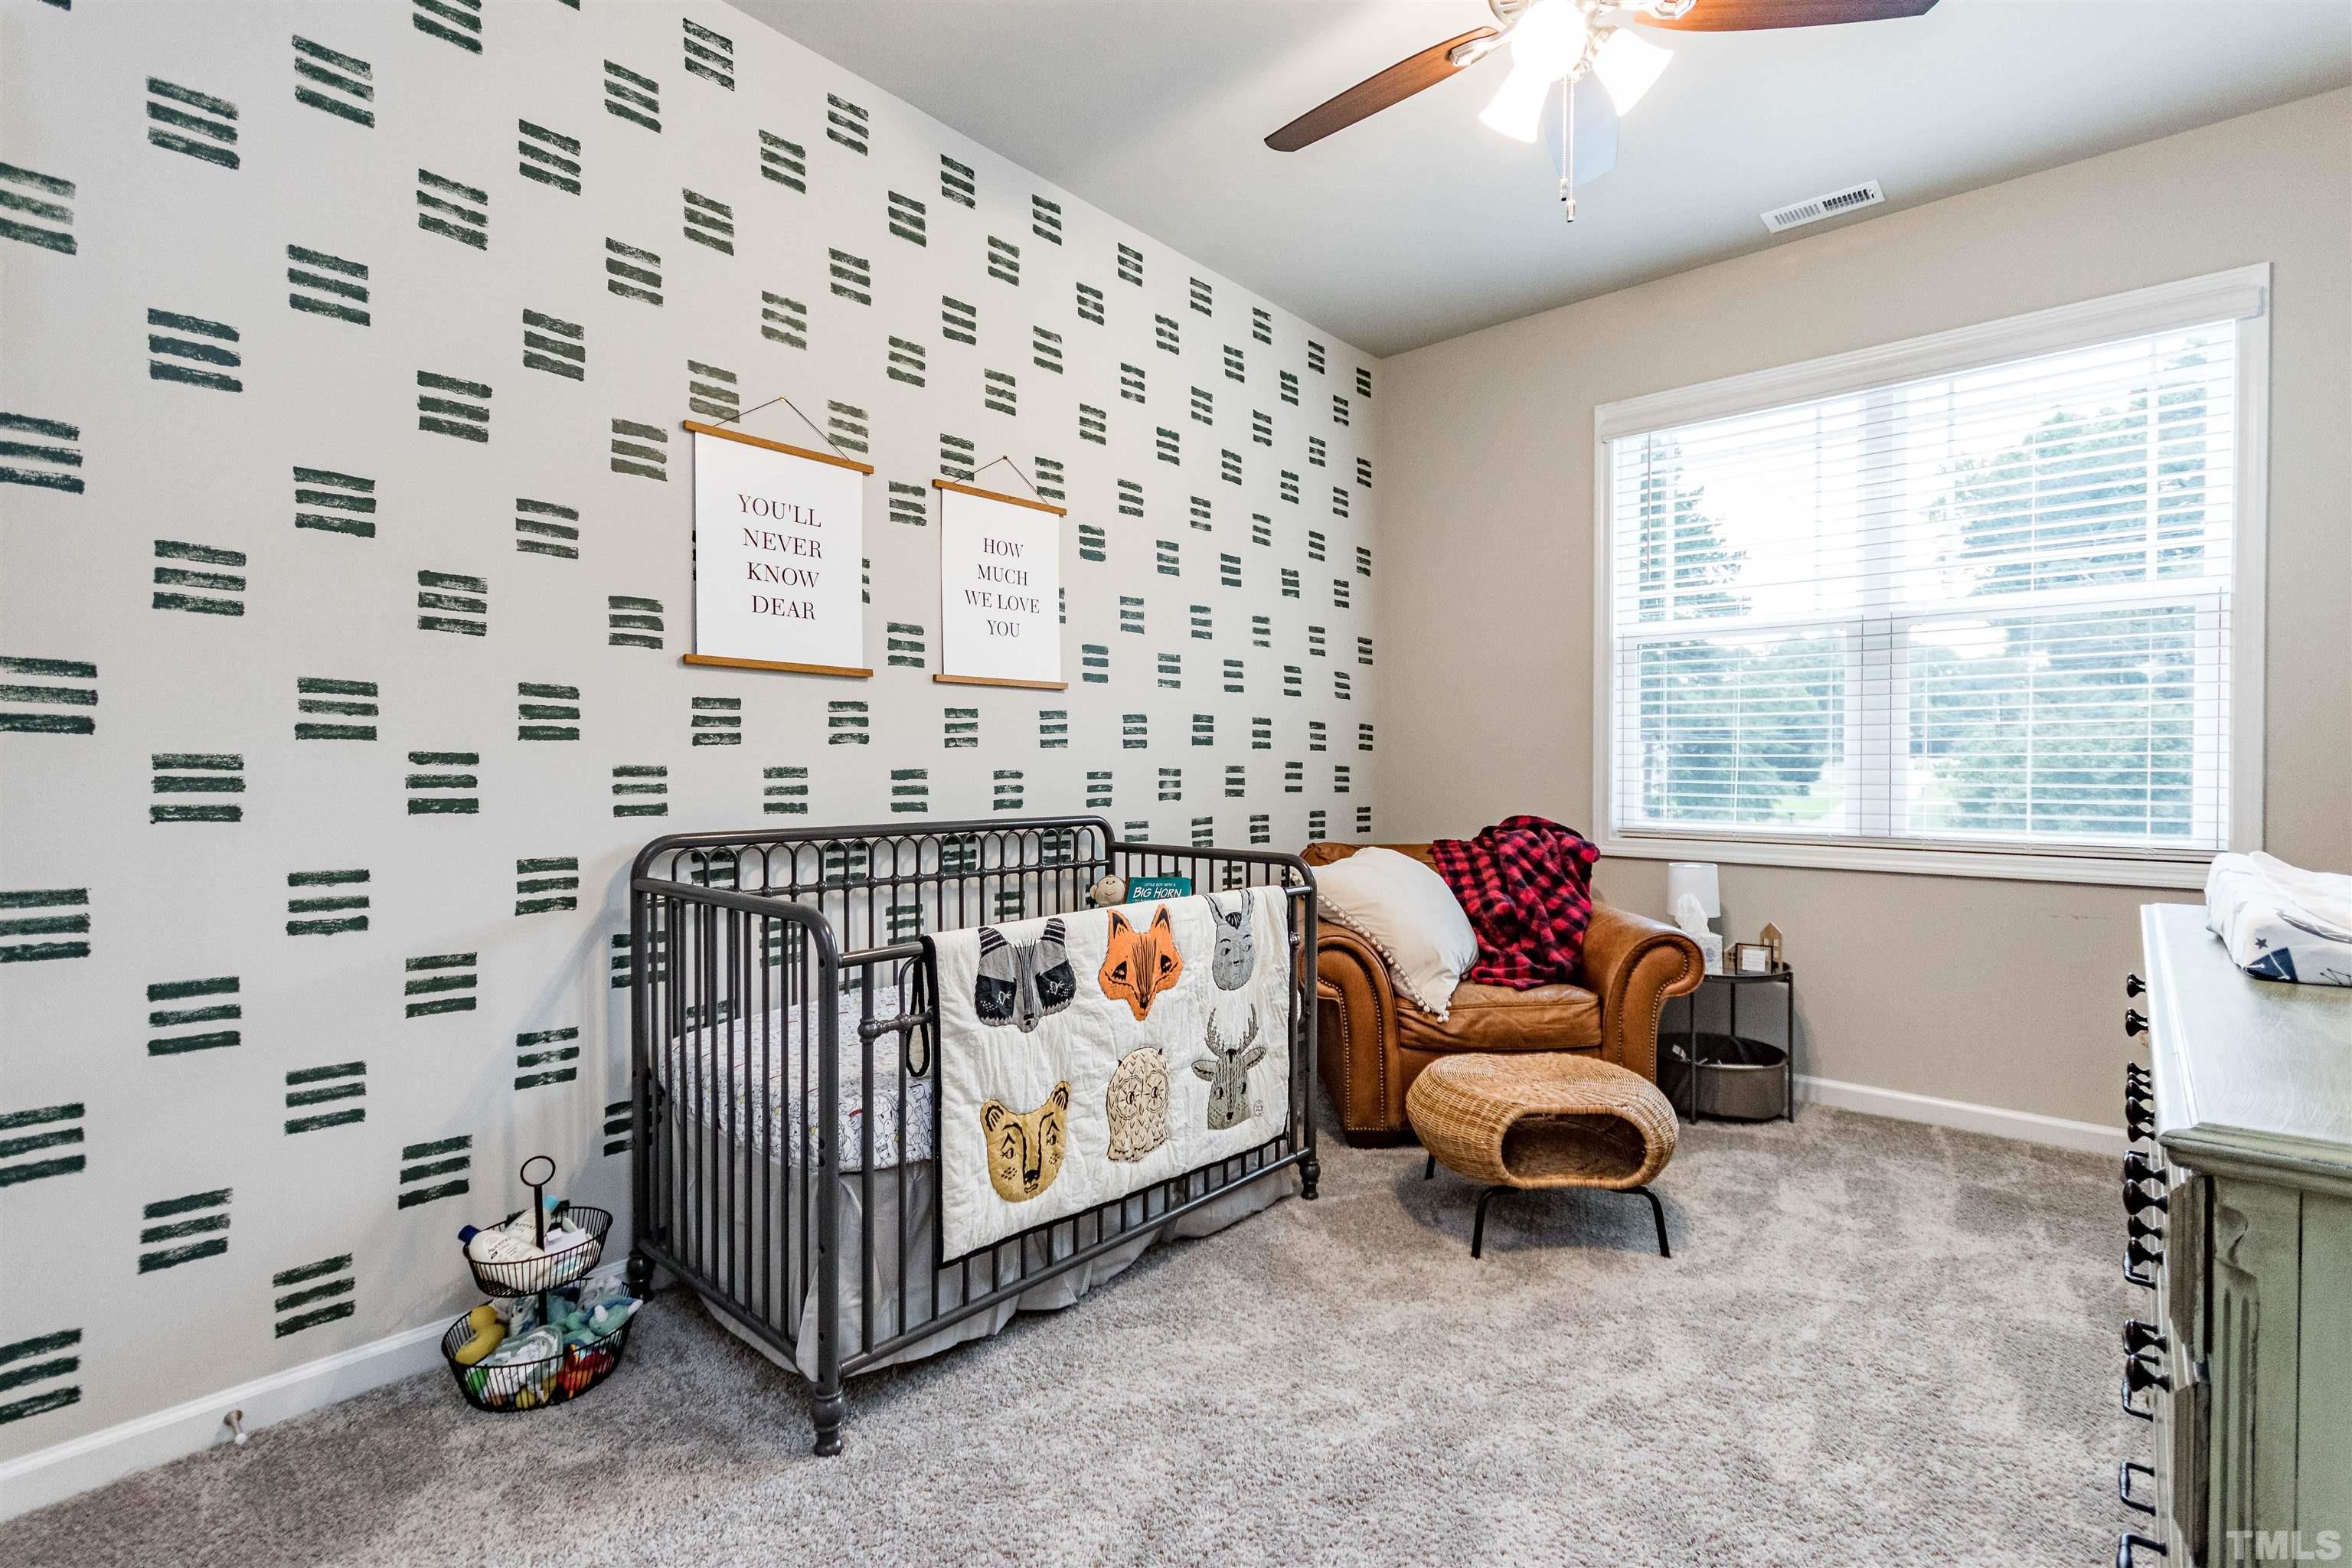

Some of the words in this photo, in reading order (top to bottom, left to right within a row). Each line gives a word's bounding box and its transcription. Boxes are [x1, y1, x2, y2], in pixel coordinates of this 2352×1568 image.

[737, 494, 822, 528] YOU'LL
[743, 528, 822, 559] NEVER
[983, 537, 1024, 558] HOW
[746, 561, 820, 589] KNOW
[977, 564, 1028, 586] MUCH
[751, 594, 816, 620] DEAR
[964, 590, 992, 608] WE
[998, 593, 1040, 614] LOVE
[986, 619, 1021, 638] YOU
[1133, 887, 1152, 899] BIG
[1153, 887, 1182, 899] HORN
